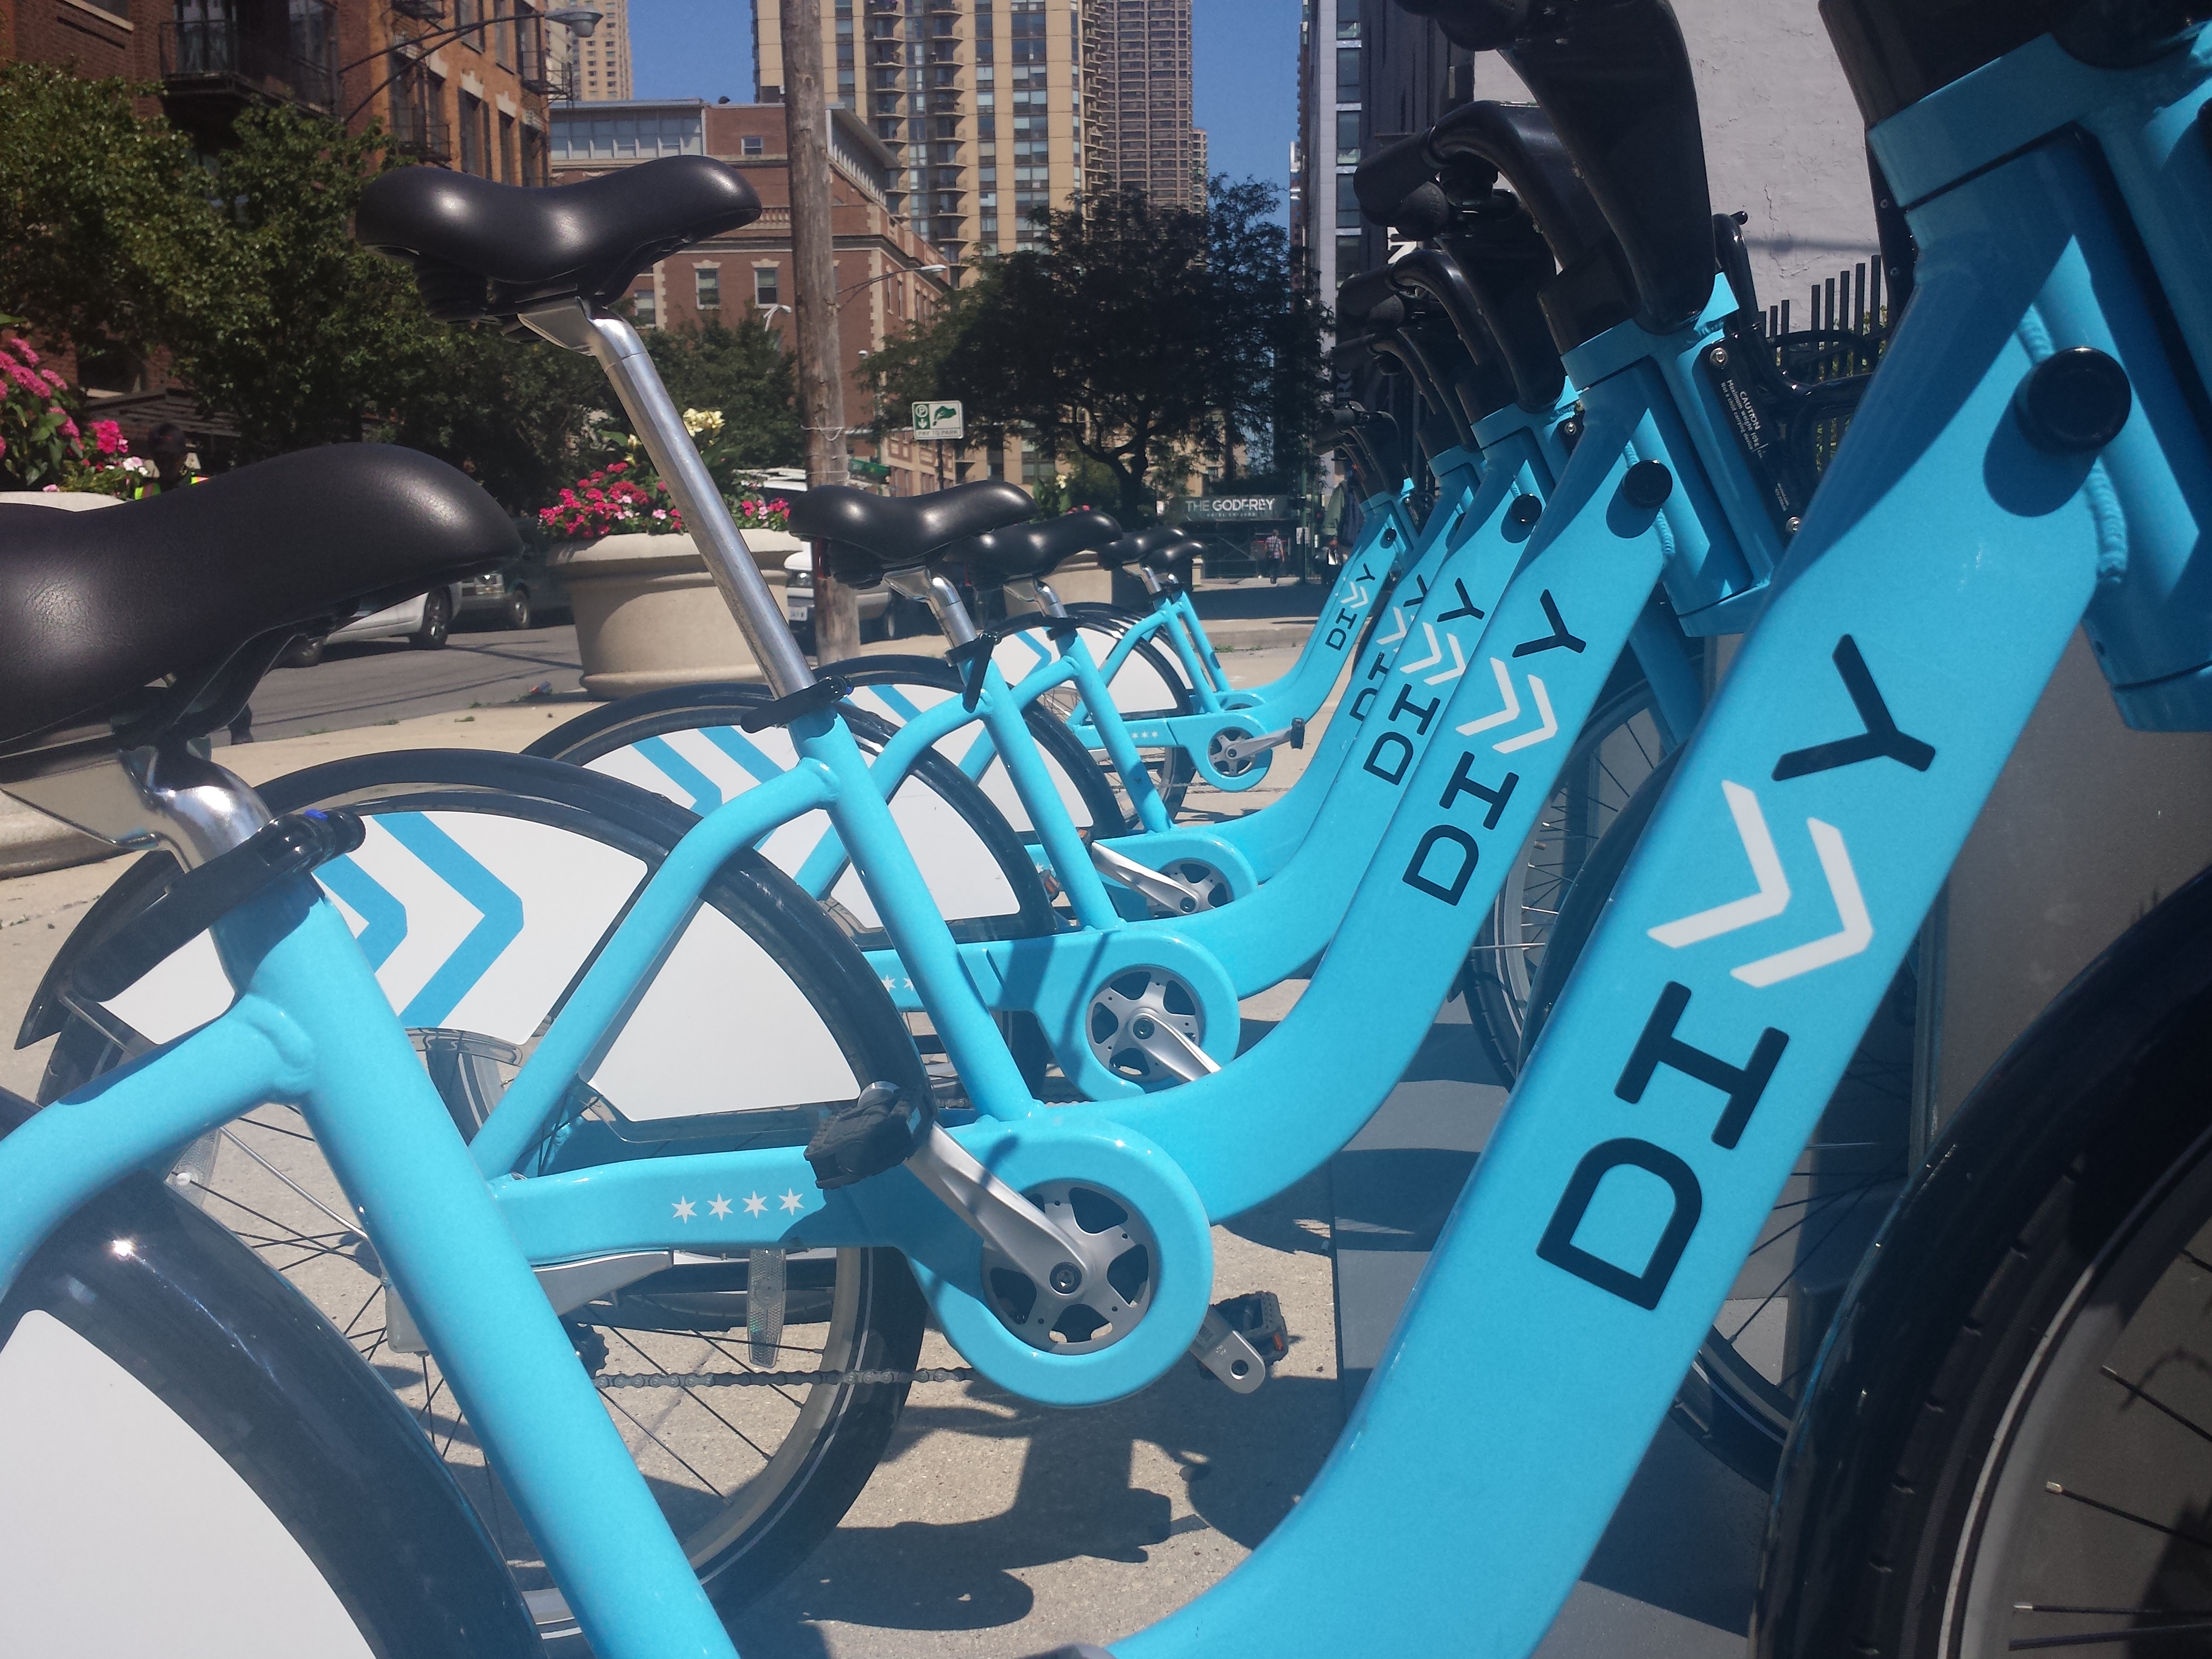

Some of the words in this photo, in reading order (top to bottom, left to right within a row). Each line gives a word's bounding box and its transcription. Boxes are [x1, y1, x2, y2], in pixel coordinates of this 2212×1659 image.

[1727, 379, 1743, 409] Maximum
[1740, 410, 1753, 431] weight
[1751, 432, 1759, 447] 10kg
[1728, 398, 1737, 412] child
[1733, 412, 1745, 434] carrying
[1743, 433, 1753, 450] device
[1740, 391, 1761, 430] CAUTION
[1185, 500, 1209, 512] THE
[1212, 498, 1275, 512] GODFREY
